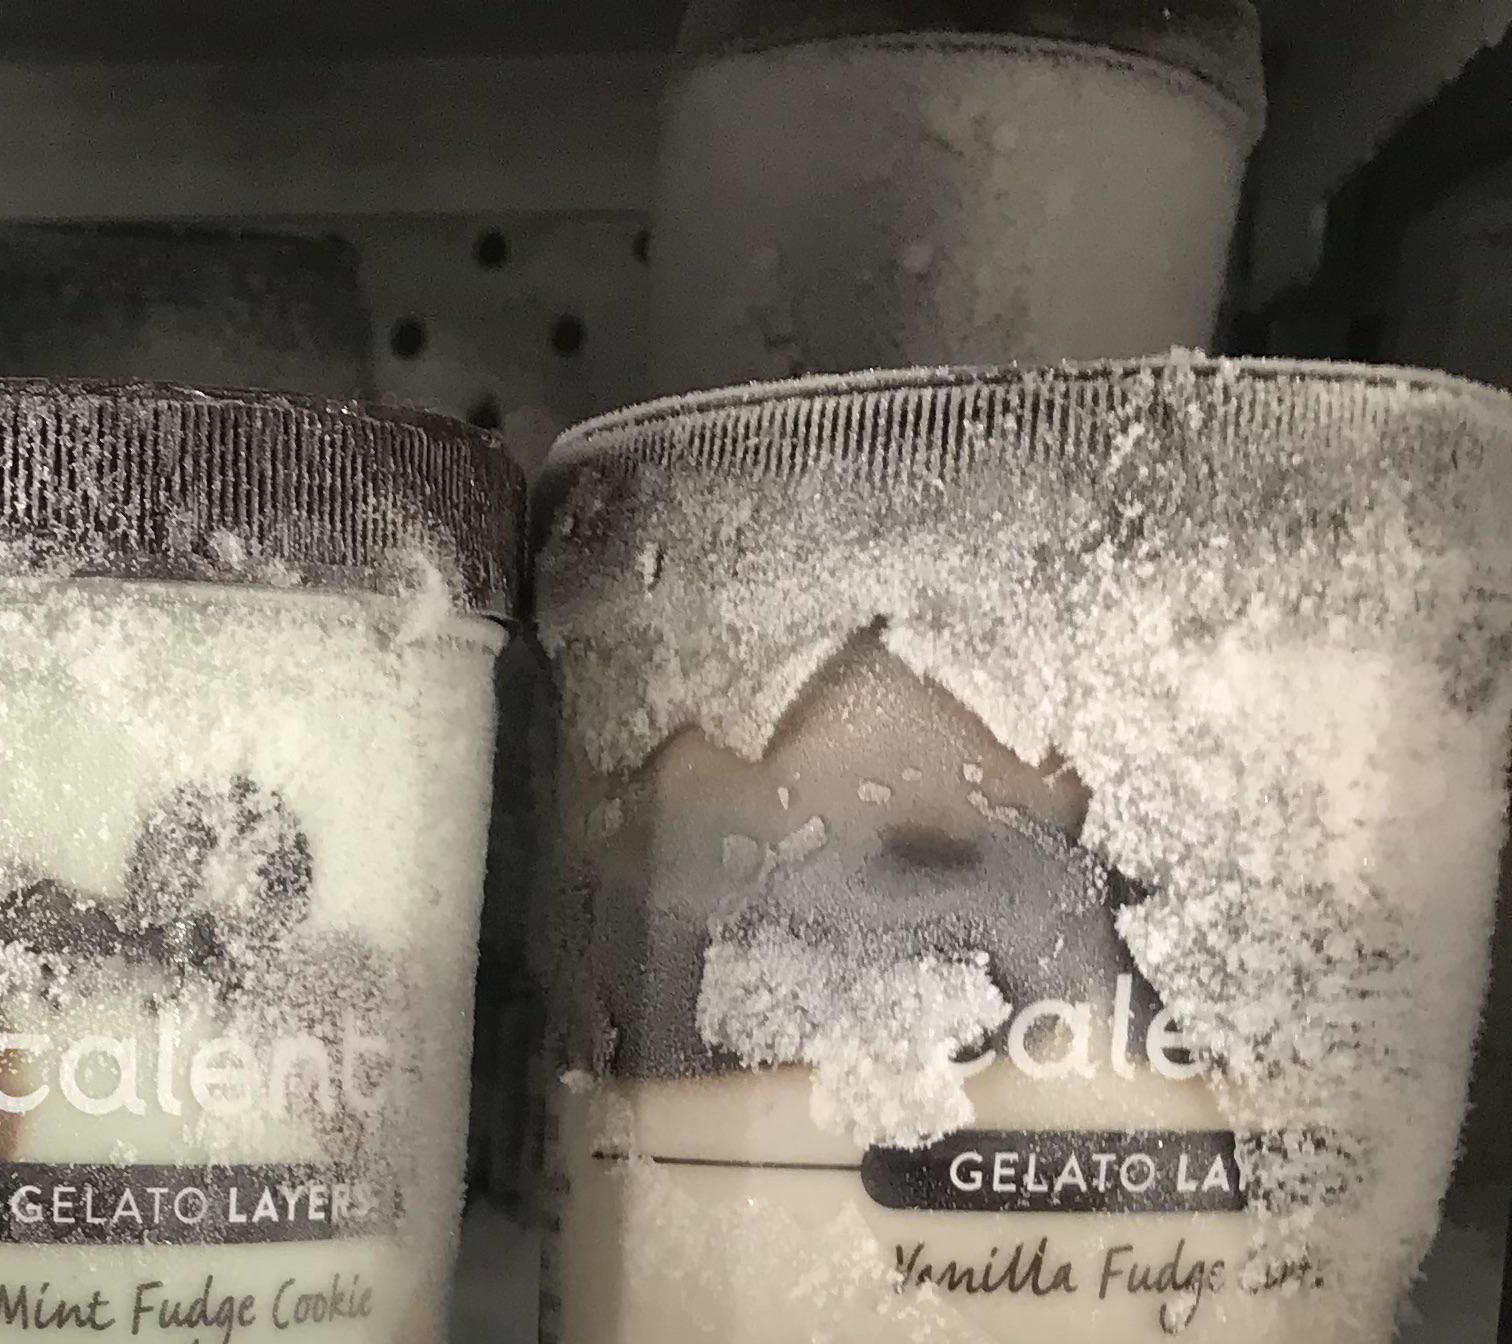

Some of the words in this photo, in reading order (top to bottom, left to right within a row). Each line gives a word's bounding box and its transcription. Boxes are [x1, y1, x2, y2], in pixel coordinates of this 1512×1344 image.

[949, 1151, 1156, 1193] GELATO
[8, 1184, 209, 1225] GELATO
[272, 1272, 374, 1331] Cookie
[893, 1235, 1078, 1296] Vanilla
[1099, 1238, 1226, 1336] Fudge
